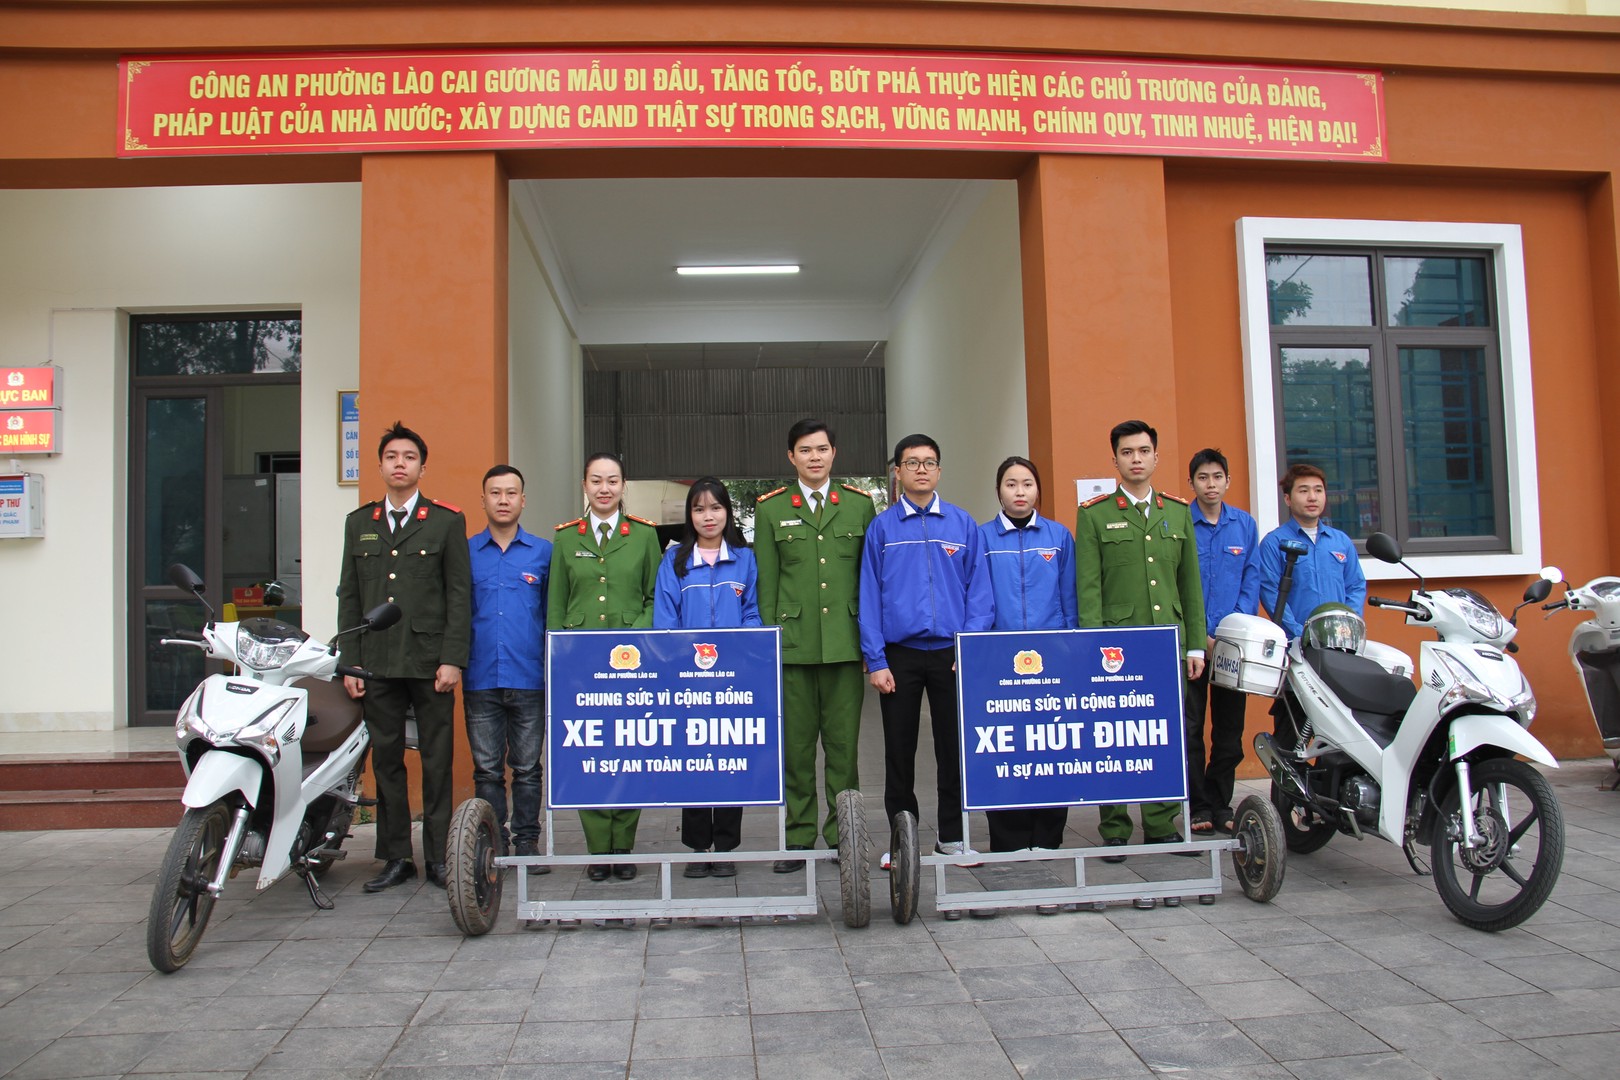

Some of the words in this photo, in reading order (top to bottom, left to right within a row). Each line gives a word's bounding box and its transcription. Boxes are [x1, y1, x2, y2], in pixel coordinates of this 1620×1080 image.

[189, 70, 250, 99] CÔNG
[256, 73, 289, 98] AN
[295, 67, 386, 97] PHƯỜNG
[392, 66, 434, 95] LÀO
[441, 69, 478, 94] CAI
[484, 68, 561, 93] GƯƠNG
[567, 59, 618, 92] MẪU
[624, 68, 647, 92] ĐI
[652, 60, 706, 95] ĐẦU,
[710, 66, 769, 93] TĂNG
[774, 60, 825, 95] TỐC,
[829, 65, 871, 94] BỨT
[876, 66, 922, 95] PHÁ
[925, 70, 981, 101] THỰC
[987, 69, 1037, 102] HIỆN
[1042, 70, 1085, 99] CÁC
[1090, 69, 1133, 101] CHỦ
[1136, 75, 1218, 104] TRƯƠNG
[1222, 74, 1264, 106] CỦA
[1266, 77, 1327, 111] ĐẢNG,
[153, 107, 214, 137] PHÁP
[220, 107, 274, 140] LUẬT
[280, 103, 326, 134] CỦA
[331, 103, 378, 133] NHÀ
[384, 105, 452, 134] NƯỚC;
[458, 101, 503, 130] XÂY
[509, 102, 571, 135] DỰNG
[577, 104, 638, 129] CAND
[644, 99, 699, 133] THẬT
[705, 104, 738, 133] SỰ
[740, 104, 815, 129] TRONG
[820, 104, 886, 135] SẠCH,
[891, 102, 951, 130] VỮNG
[956, 107, 1028, 137] MẠNH,
[1033, 105, 1098, 135] CHÍNH
[1103, 111, 1147, 139] QUY,
[1150, 113, 1199, 138] TINH
[1202, 112, 1264, 145] NHUỆ,
[1267, 113, 1315, 147] HIỆN
[1317, 120, 1359, 150] ĐẠI!
[22, 390, 47, 401] BAN
[3, 434, 18, 446] BAN
[38, 434, 50, 447] SỰ
[7, 498, 21, 507] THƯ
[576, 692, 622, 706] CHUNG
[626, 687, 653, 706] SỨC
[658, 688, 670, 706] VÌ
[675, 689, 712, 708] CỘNG
[715, 685, 753, 705] ĐỒNG
[986, 698, 1031, 713] CHUNG
[1035, 693, 1061, 711] SỨC
[1065, 693, 1077, 710] VÌ
[1081, 693, 1116, 712] CỘNG
[1119, 689, 1154, 708] ĐỒNG
[562, 719, 604, 747] XE
[615, 712, 676, 747] HÚT
[686, 717, 766, 746] ĐINH
[975, 726, 1015, 754] XE
[1025, 716, 1084, 752] HÚT
[1094, 718, 1168, 748] ĐINH
[582, 756, 596, 773] VÌ
[600, 758, 620, 776] SỰ
[622, 759, 641, 772] AN
[646, 755, 682, 772] TOÀN
[718, 758, 747, 774] BẠN
[996, 761, 1009, 778] VÌ
[1013, 762, 1033, 779] SỰ
[1035, 763, 1054, 776] AN
[1057, 759, 1092, 775] TOÀN
[1096, 756, 1122, 774] CỦA
[1126, 758, 1153, 776] BẠN
